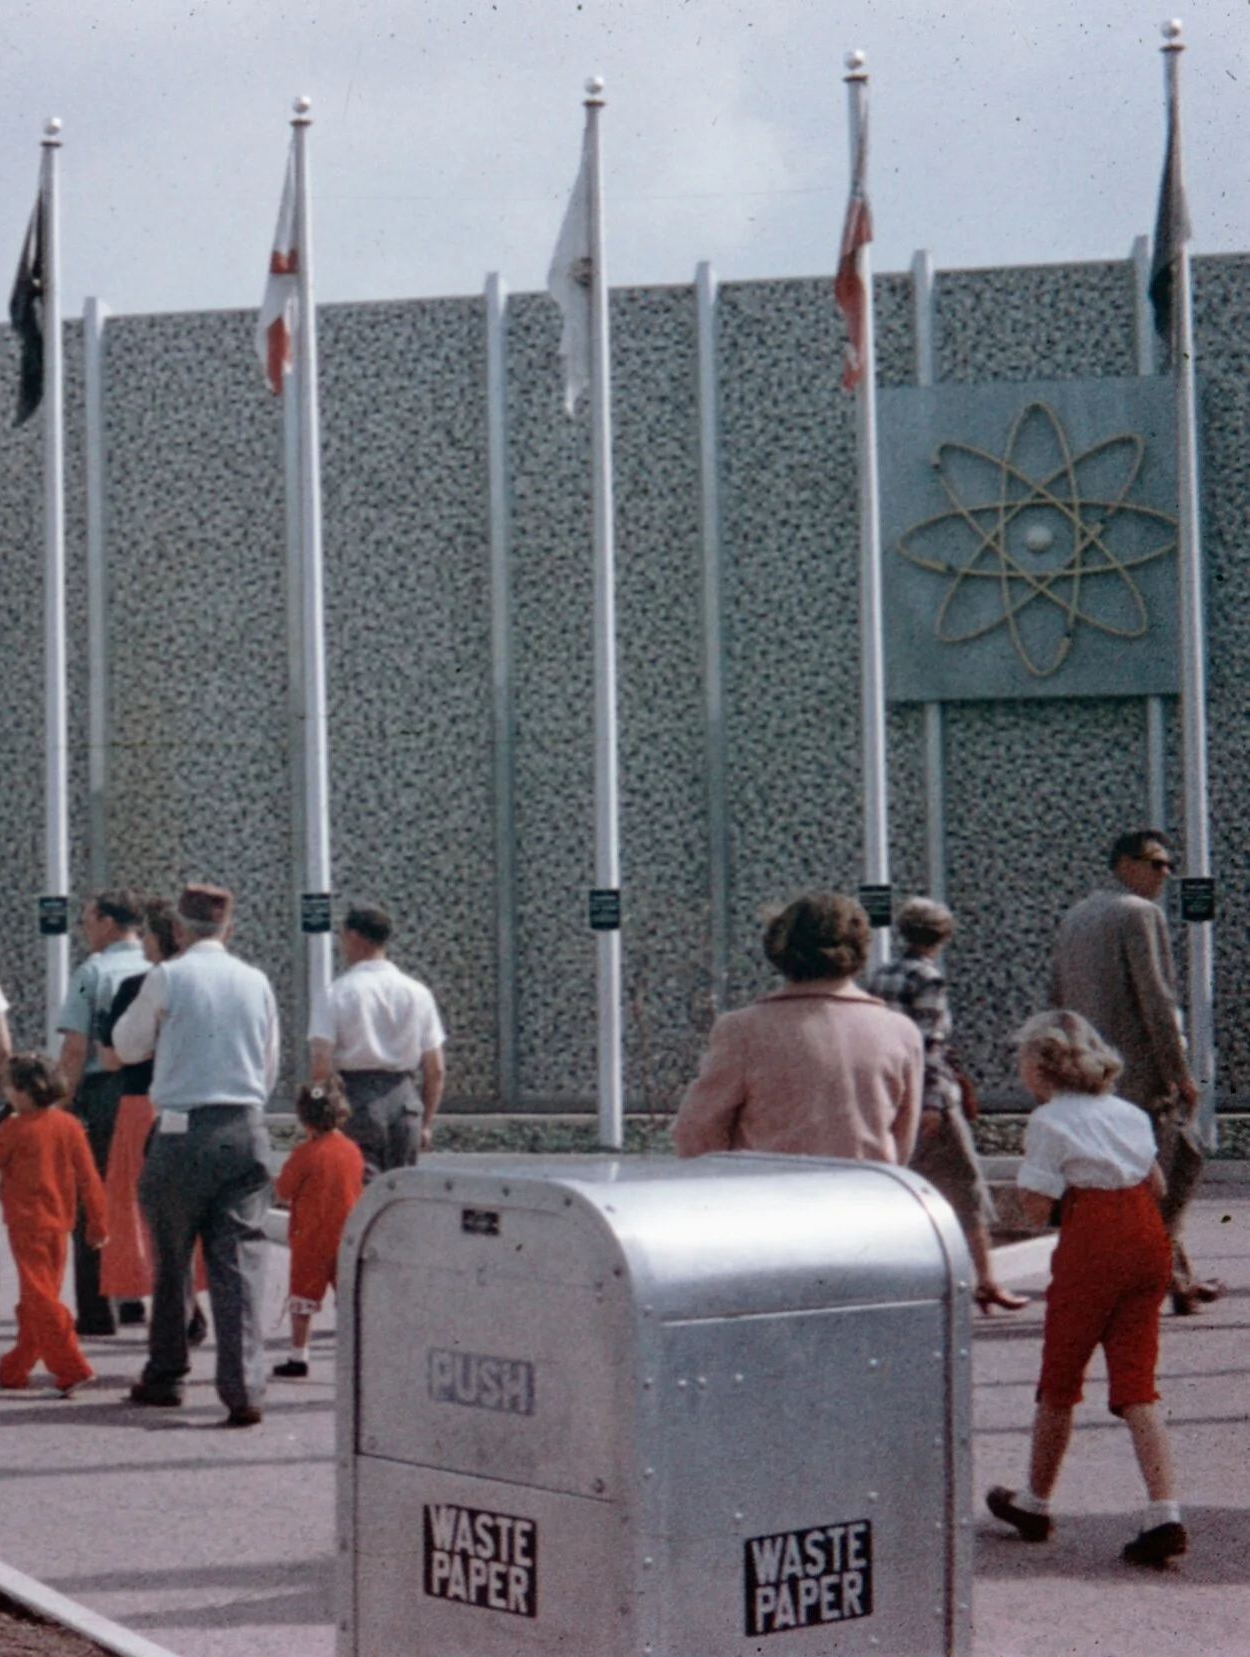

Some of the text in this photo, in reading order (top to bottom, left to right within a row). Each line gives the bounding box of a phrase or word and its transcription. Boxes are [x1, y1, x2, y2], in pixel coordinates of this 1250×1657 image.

[429, 1350, 530, 1413] PUSH
[429, 1504, 533, 1568] WASTE
[750, 1521, 868, 1586] WASTE
[430, 1550, 530, 1614] PAPER
[755, 1570, 865, 1633] PAPER
